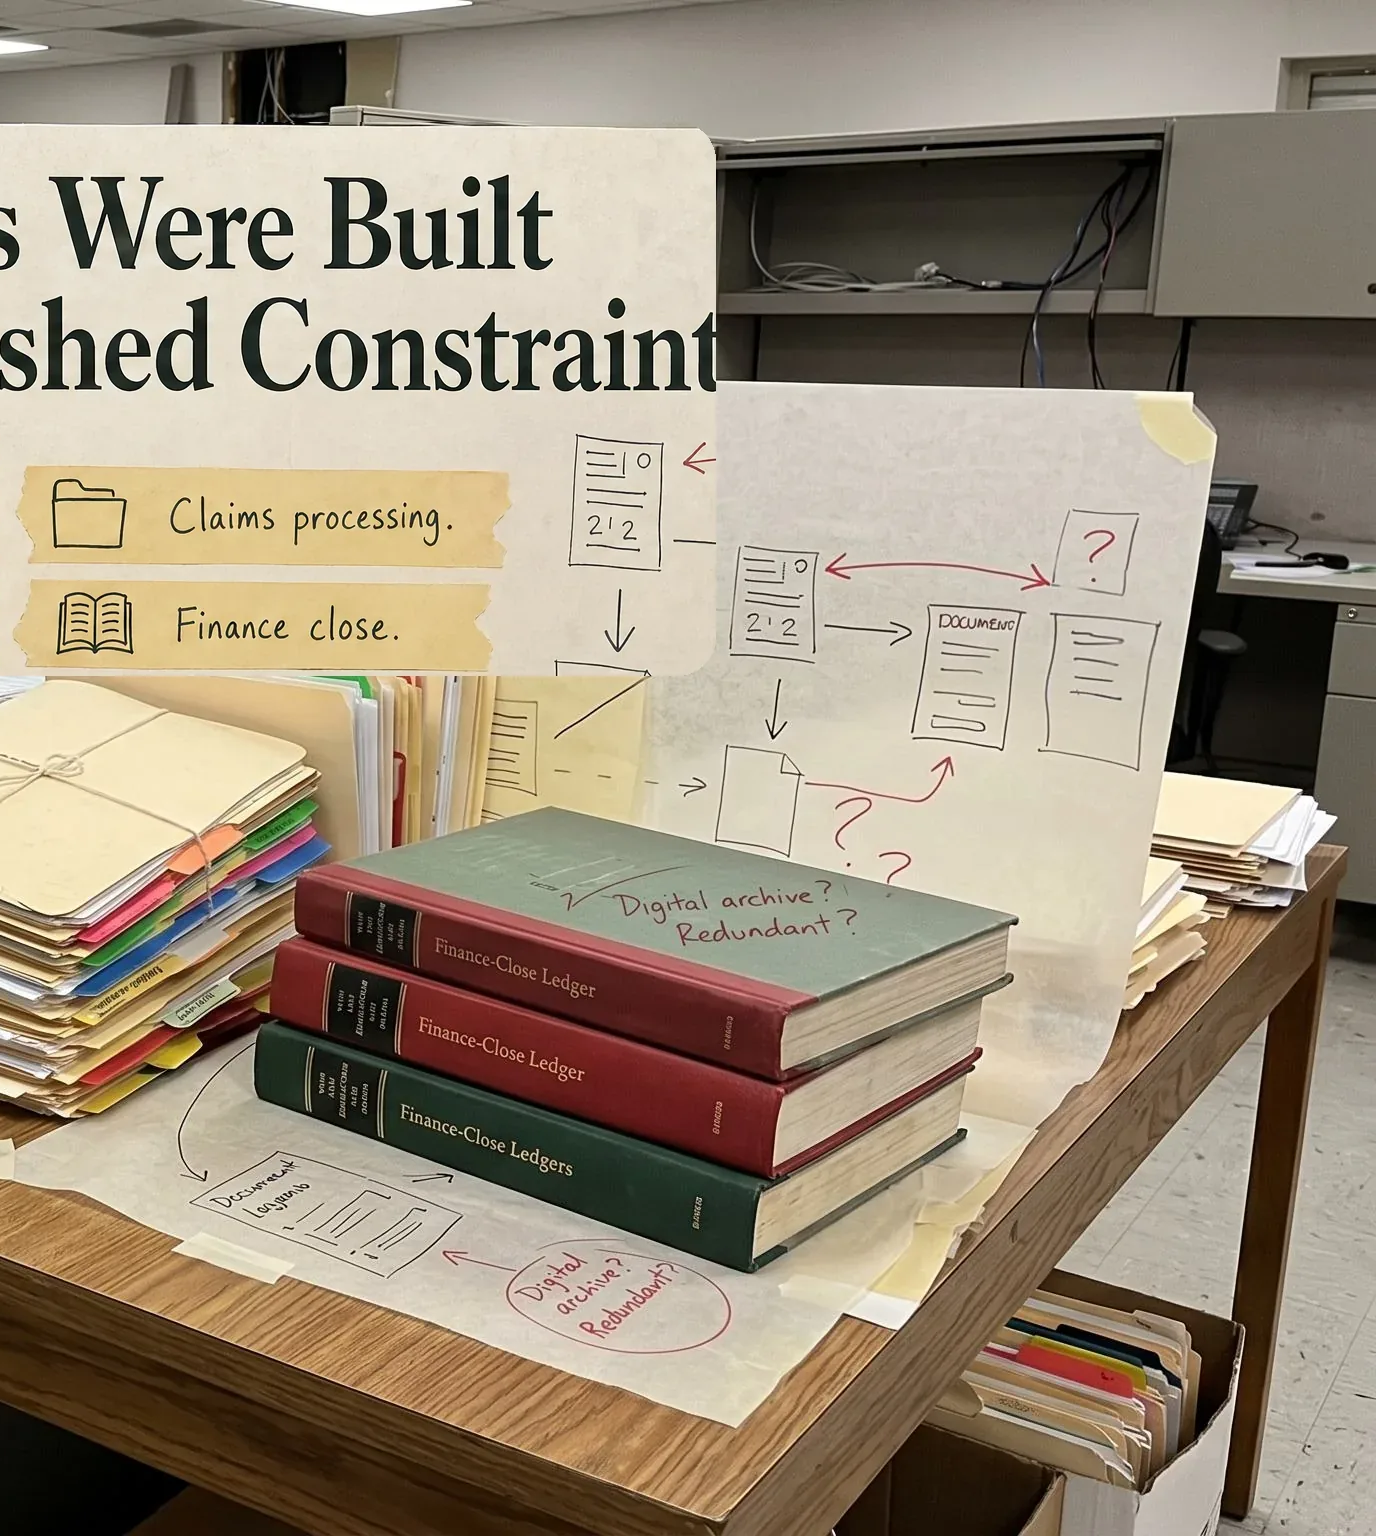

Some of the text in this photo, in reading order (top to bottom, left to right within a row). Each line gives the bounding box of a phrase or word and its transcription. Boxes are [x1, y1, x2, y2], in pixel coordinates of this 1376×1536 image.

[612, 879, 832, 925] Digital archive?
[434, 937, 597, 999] Finance-Close Ledger
[418, 1015, 586, 1083] Finance-Close Ledger
[399, 1103, 574, 1177] Finance-Close Ledgers
[514, 1251, 589, 1301] Digital
[557, 1257, 632, 1315] archive?
